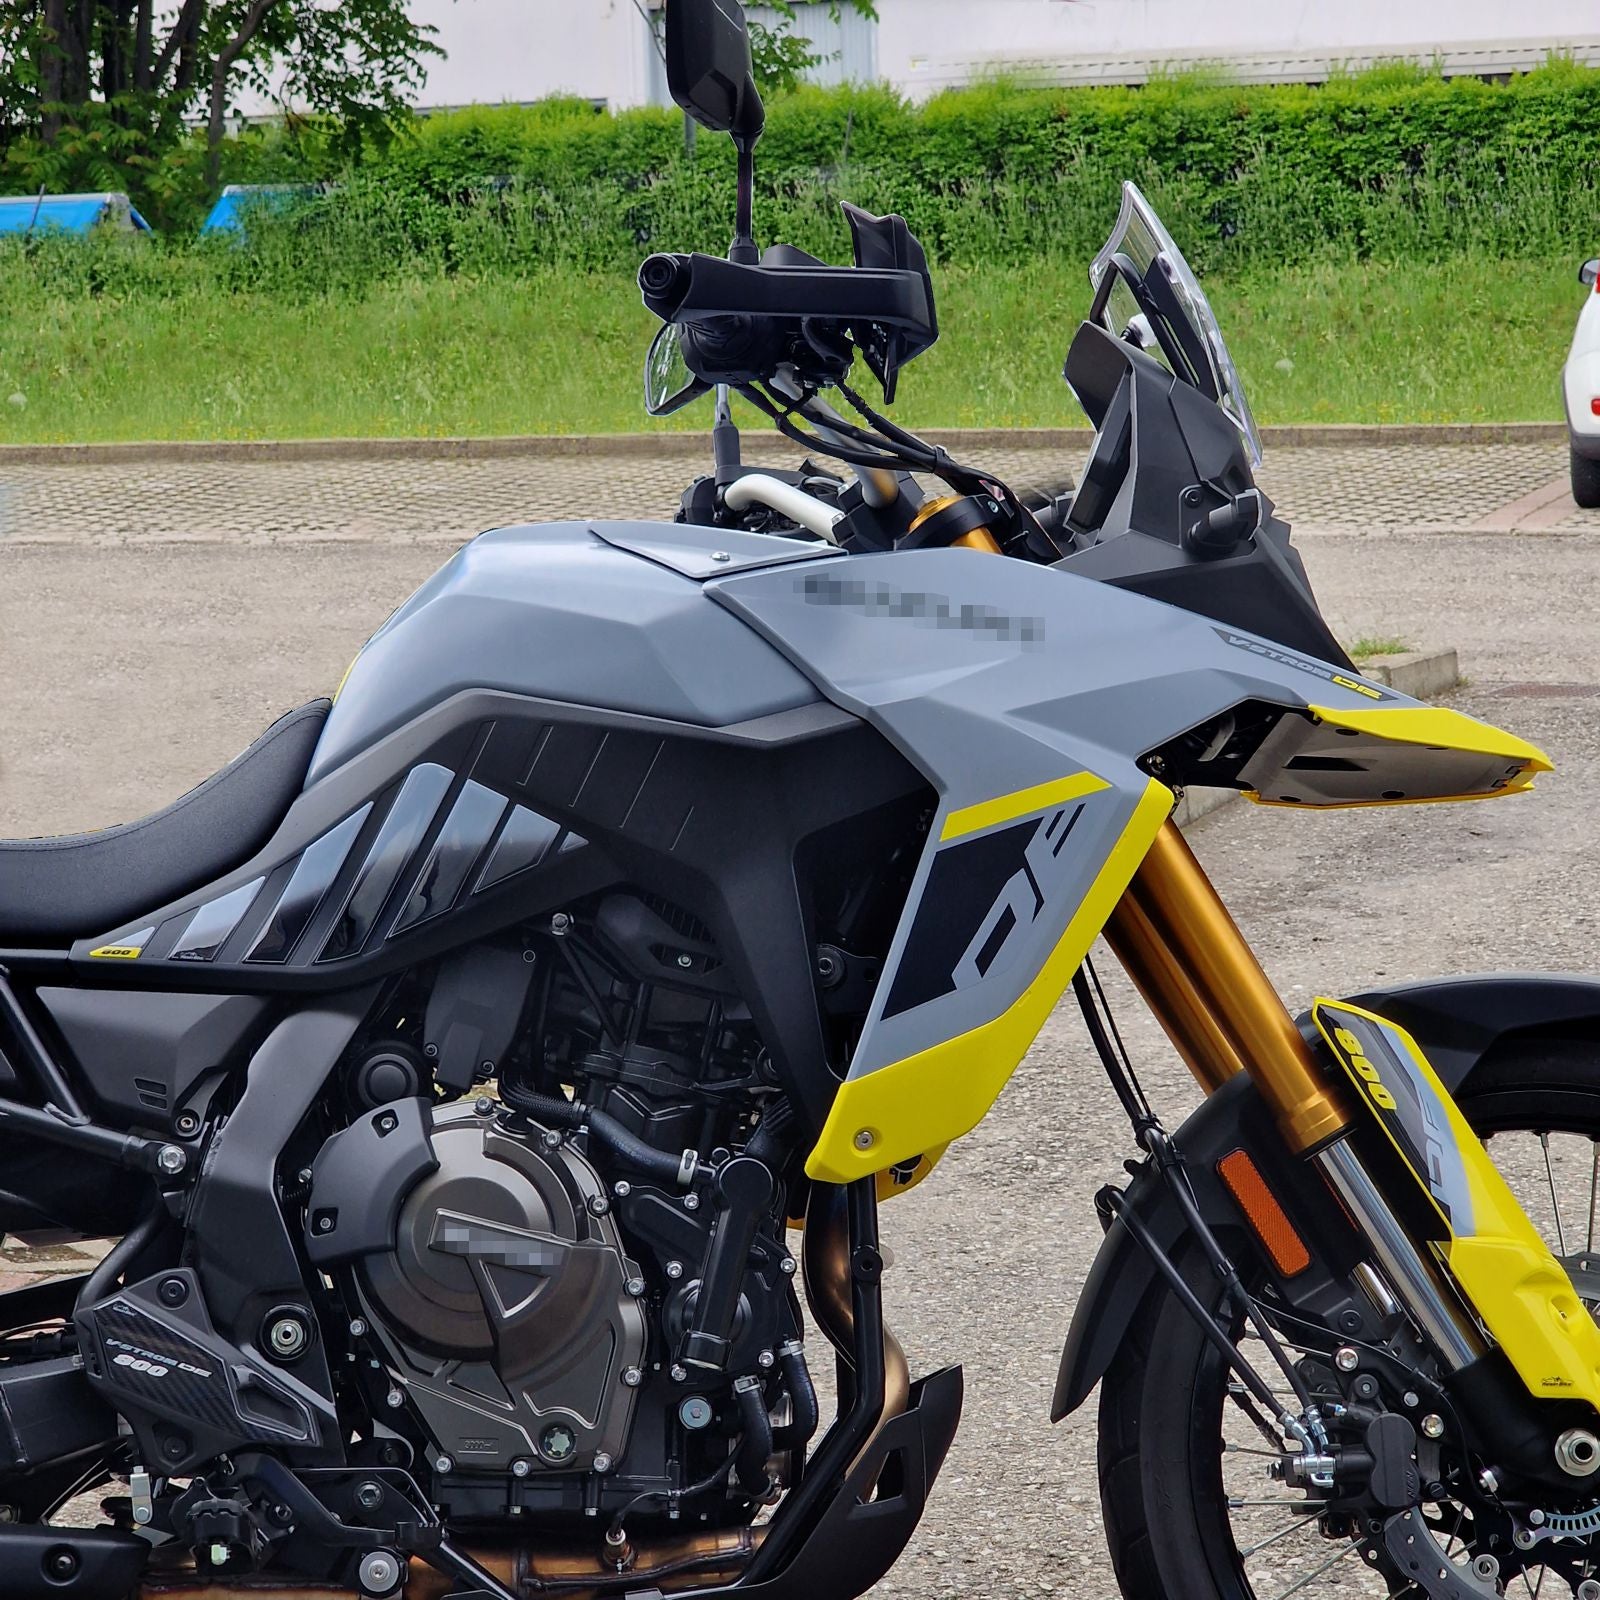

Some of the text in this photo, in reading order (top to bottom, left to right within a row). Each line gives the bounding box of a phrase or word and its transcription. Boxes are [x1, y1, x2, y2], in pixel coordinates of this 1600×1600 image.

[1228, 635, 1383, 699] V-STROM DE
[1334, 1027, 1397, 1110] 800
[113, 1354, 169, 1377] 800
[177, 1362, 213, 1378] DE
